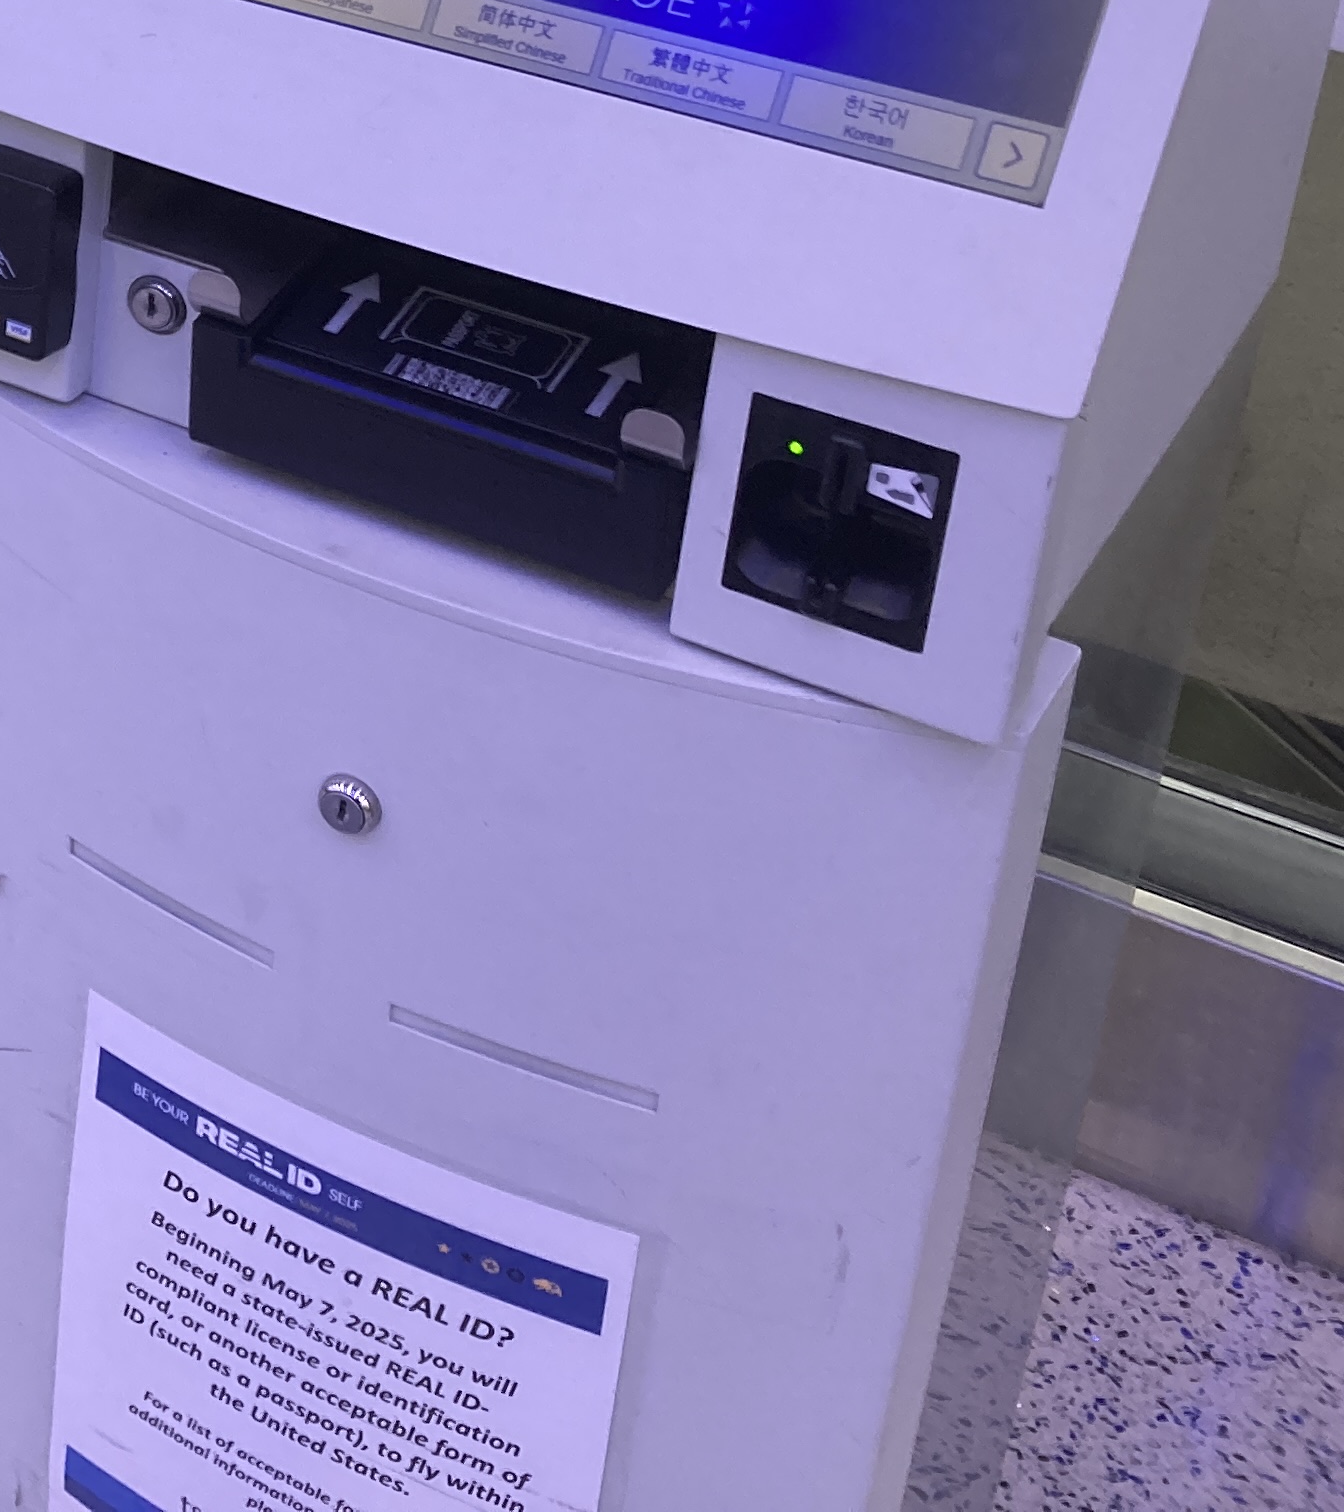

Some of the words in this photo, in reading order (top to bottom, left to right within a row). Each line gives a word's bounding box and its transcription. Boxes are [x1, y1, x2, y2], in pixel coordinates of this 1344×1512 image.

[453, 24, 514, 52] Simplified
[516, 39, 567, 65] Chinese
[478, 3, 558, 42] 简体中文
[623, 67, 688, 97] Traditional
[691, 84, 746, 111] Chinese
[843, 93, 910, 130] 한국어
[843, 124, 893, 148] Korean
[133, 1082, 149, 1102] BE
[149, 1092, 189, 1126] YOUR
[195, 1114, 284, 1180] REAL
[287, 1162, 322, 1196] ID
[328, 1187, 363, 1212] SELF
[151, 1211, 256, 1282] Beginning
[262, 1272, 313, 1309] May
[319, 1300, 337, 1324] 7,
[345, 1315, 410, 1356] 2025,
[418, 1348, 464, 1377] you
[471, 1370, 518, 1397] will
[163, 1170, 199, 1203] Do
[206, 1198, 257, 1236] you
[265, 1224, 335, 1274] have
[344, 1269, 363, 1288] a
[371, 1277, 449, 1326] REAL
[459, 1314, 515, 1348] ID?
[126, 1281, 174, 1320] card,
[181, 1314, 205, 1333] or
[208, 1330, 296, 1383] another
[300, 1380, 429, 1447] acceptable
[431, 1439, 495, 1475] form
[501, 1469, 532, 1490] of
[136, 1260, 241, 1327] compliant
[245, 1319, 320, 1369] license
[326, 1365, 352, 1383] or
[356, 1375, 522, 1458] identification
[166, 1250, 219, 1287] need
[222, 1283, 237, 1297] a
[241, 1292, 380, 1368] state-issued
[385, 1360, 446, 1398] REAL
[453, 1390, 489, 1412] ID-
[123, 1303, 145, 1325] ID
[149, 1320, 203, 1361] (such
[208, 1357, 232, 1378] as
[237, 1374, 251, 1388] a
[255, 1385, 369, 1451] passport),
[378, 1442, 402, 1463] to
[405, 1456, 440, 1480] fly
[447, 1473, 525, 1512] within
[128, 1403, 211, 1460] additional
[144, 1390, 170, 1413] For
[172, 1411, 183, 1422] a
[187, 1417, 212, 1440] list
[215, 1437, 235, 1453] of
[236, 1449, 331, 1505] acceptable
[210, 1383, 245, 1412] the
[250, 1405, 327, 1455] United
[330, 1448, 410, 1496] States.
